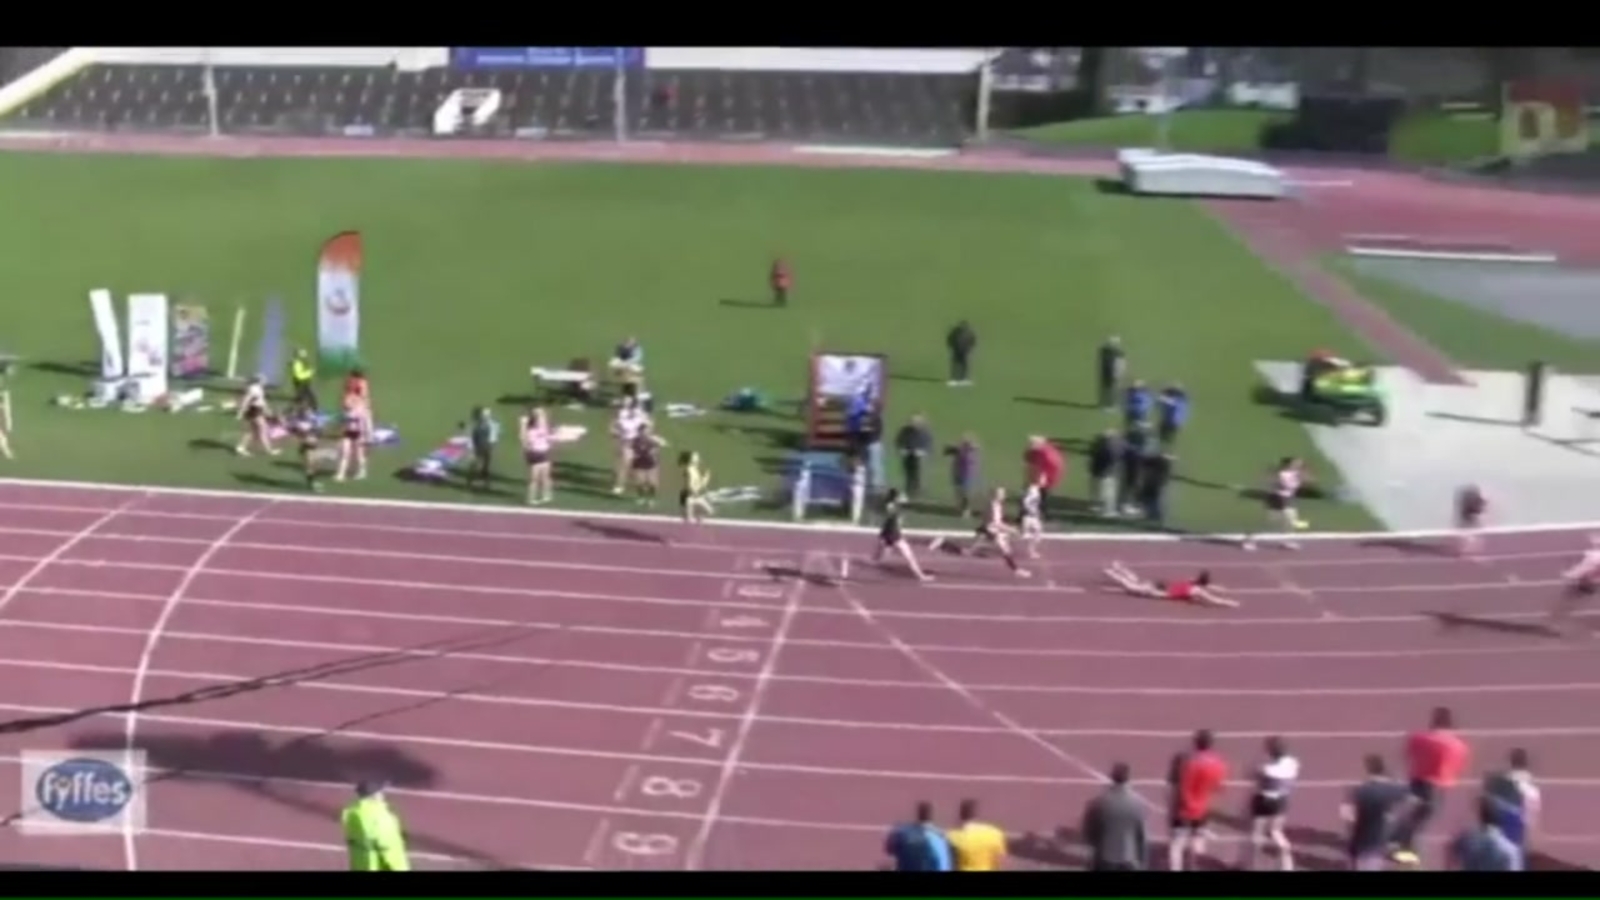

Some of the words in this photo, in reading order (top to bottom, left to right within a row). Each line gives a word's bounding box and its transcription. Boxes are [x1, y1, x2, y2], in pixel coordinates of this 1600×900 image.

[668, 727, 724, 747] 7
[641, 776, 702, 798] 8
[612, 831, 678, 855] 9
